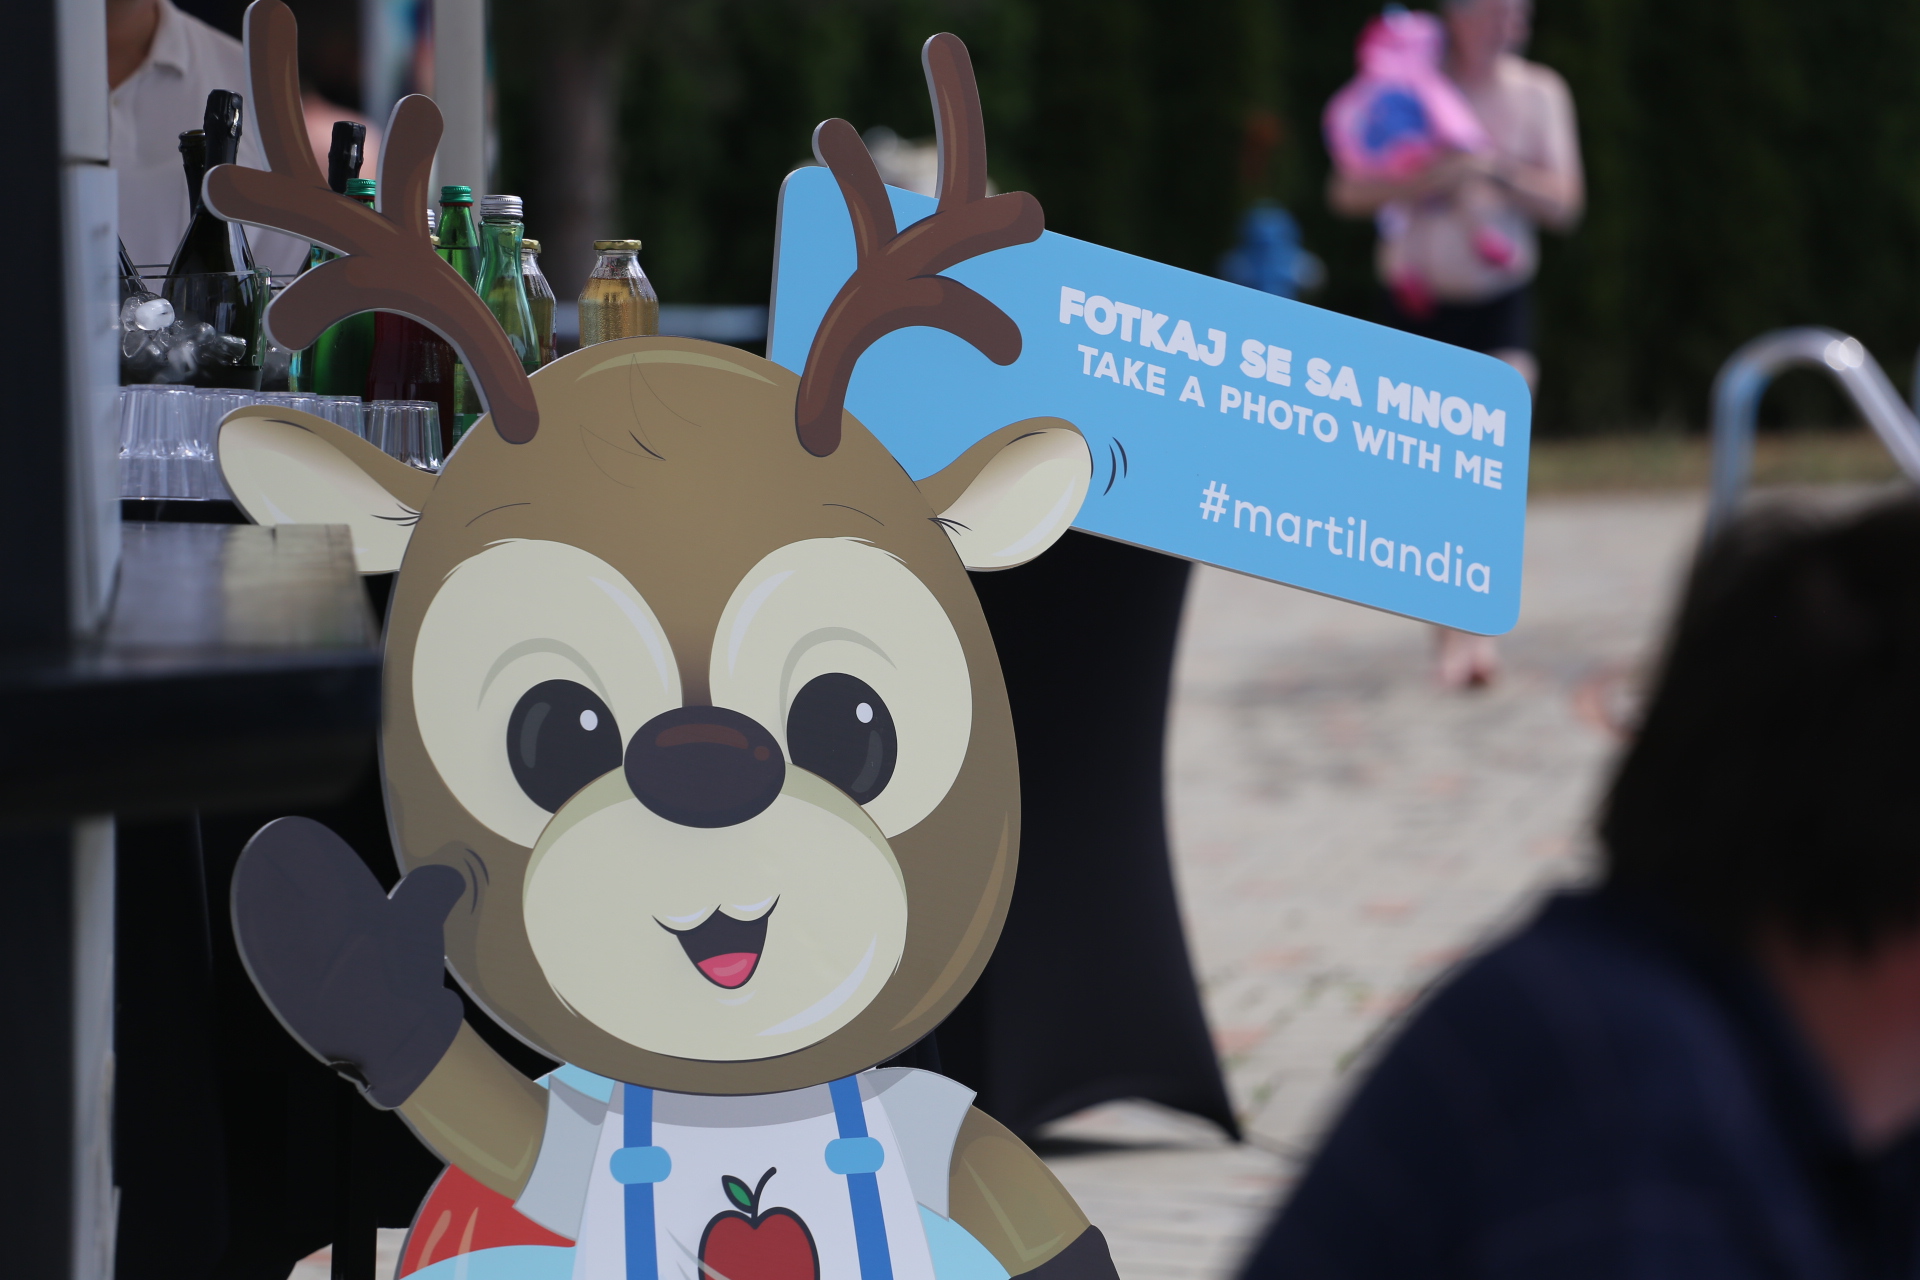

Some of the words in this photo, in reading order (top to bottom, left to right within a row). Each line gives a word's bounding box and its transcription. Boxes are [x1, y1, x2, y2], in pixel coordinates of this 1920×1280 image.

[1059, 285, 1227, 367] FOTKAJ
[1239, 338, 1293, 387] SE
[1305, 357, 1363, 407] SA
[1377, 376, 1507, 447] MNOM
[1077, 344, 1167, 396] TAKE
[1179, 375, 1205, 408] A
[1220, 384, 1339, 443] PHOTO
[1352, 421, 1441, 473] WITH
[1455, 450, 1503, 490] ME
[1199, 480, 1491, 594] #martilandia
